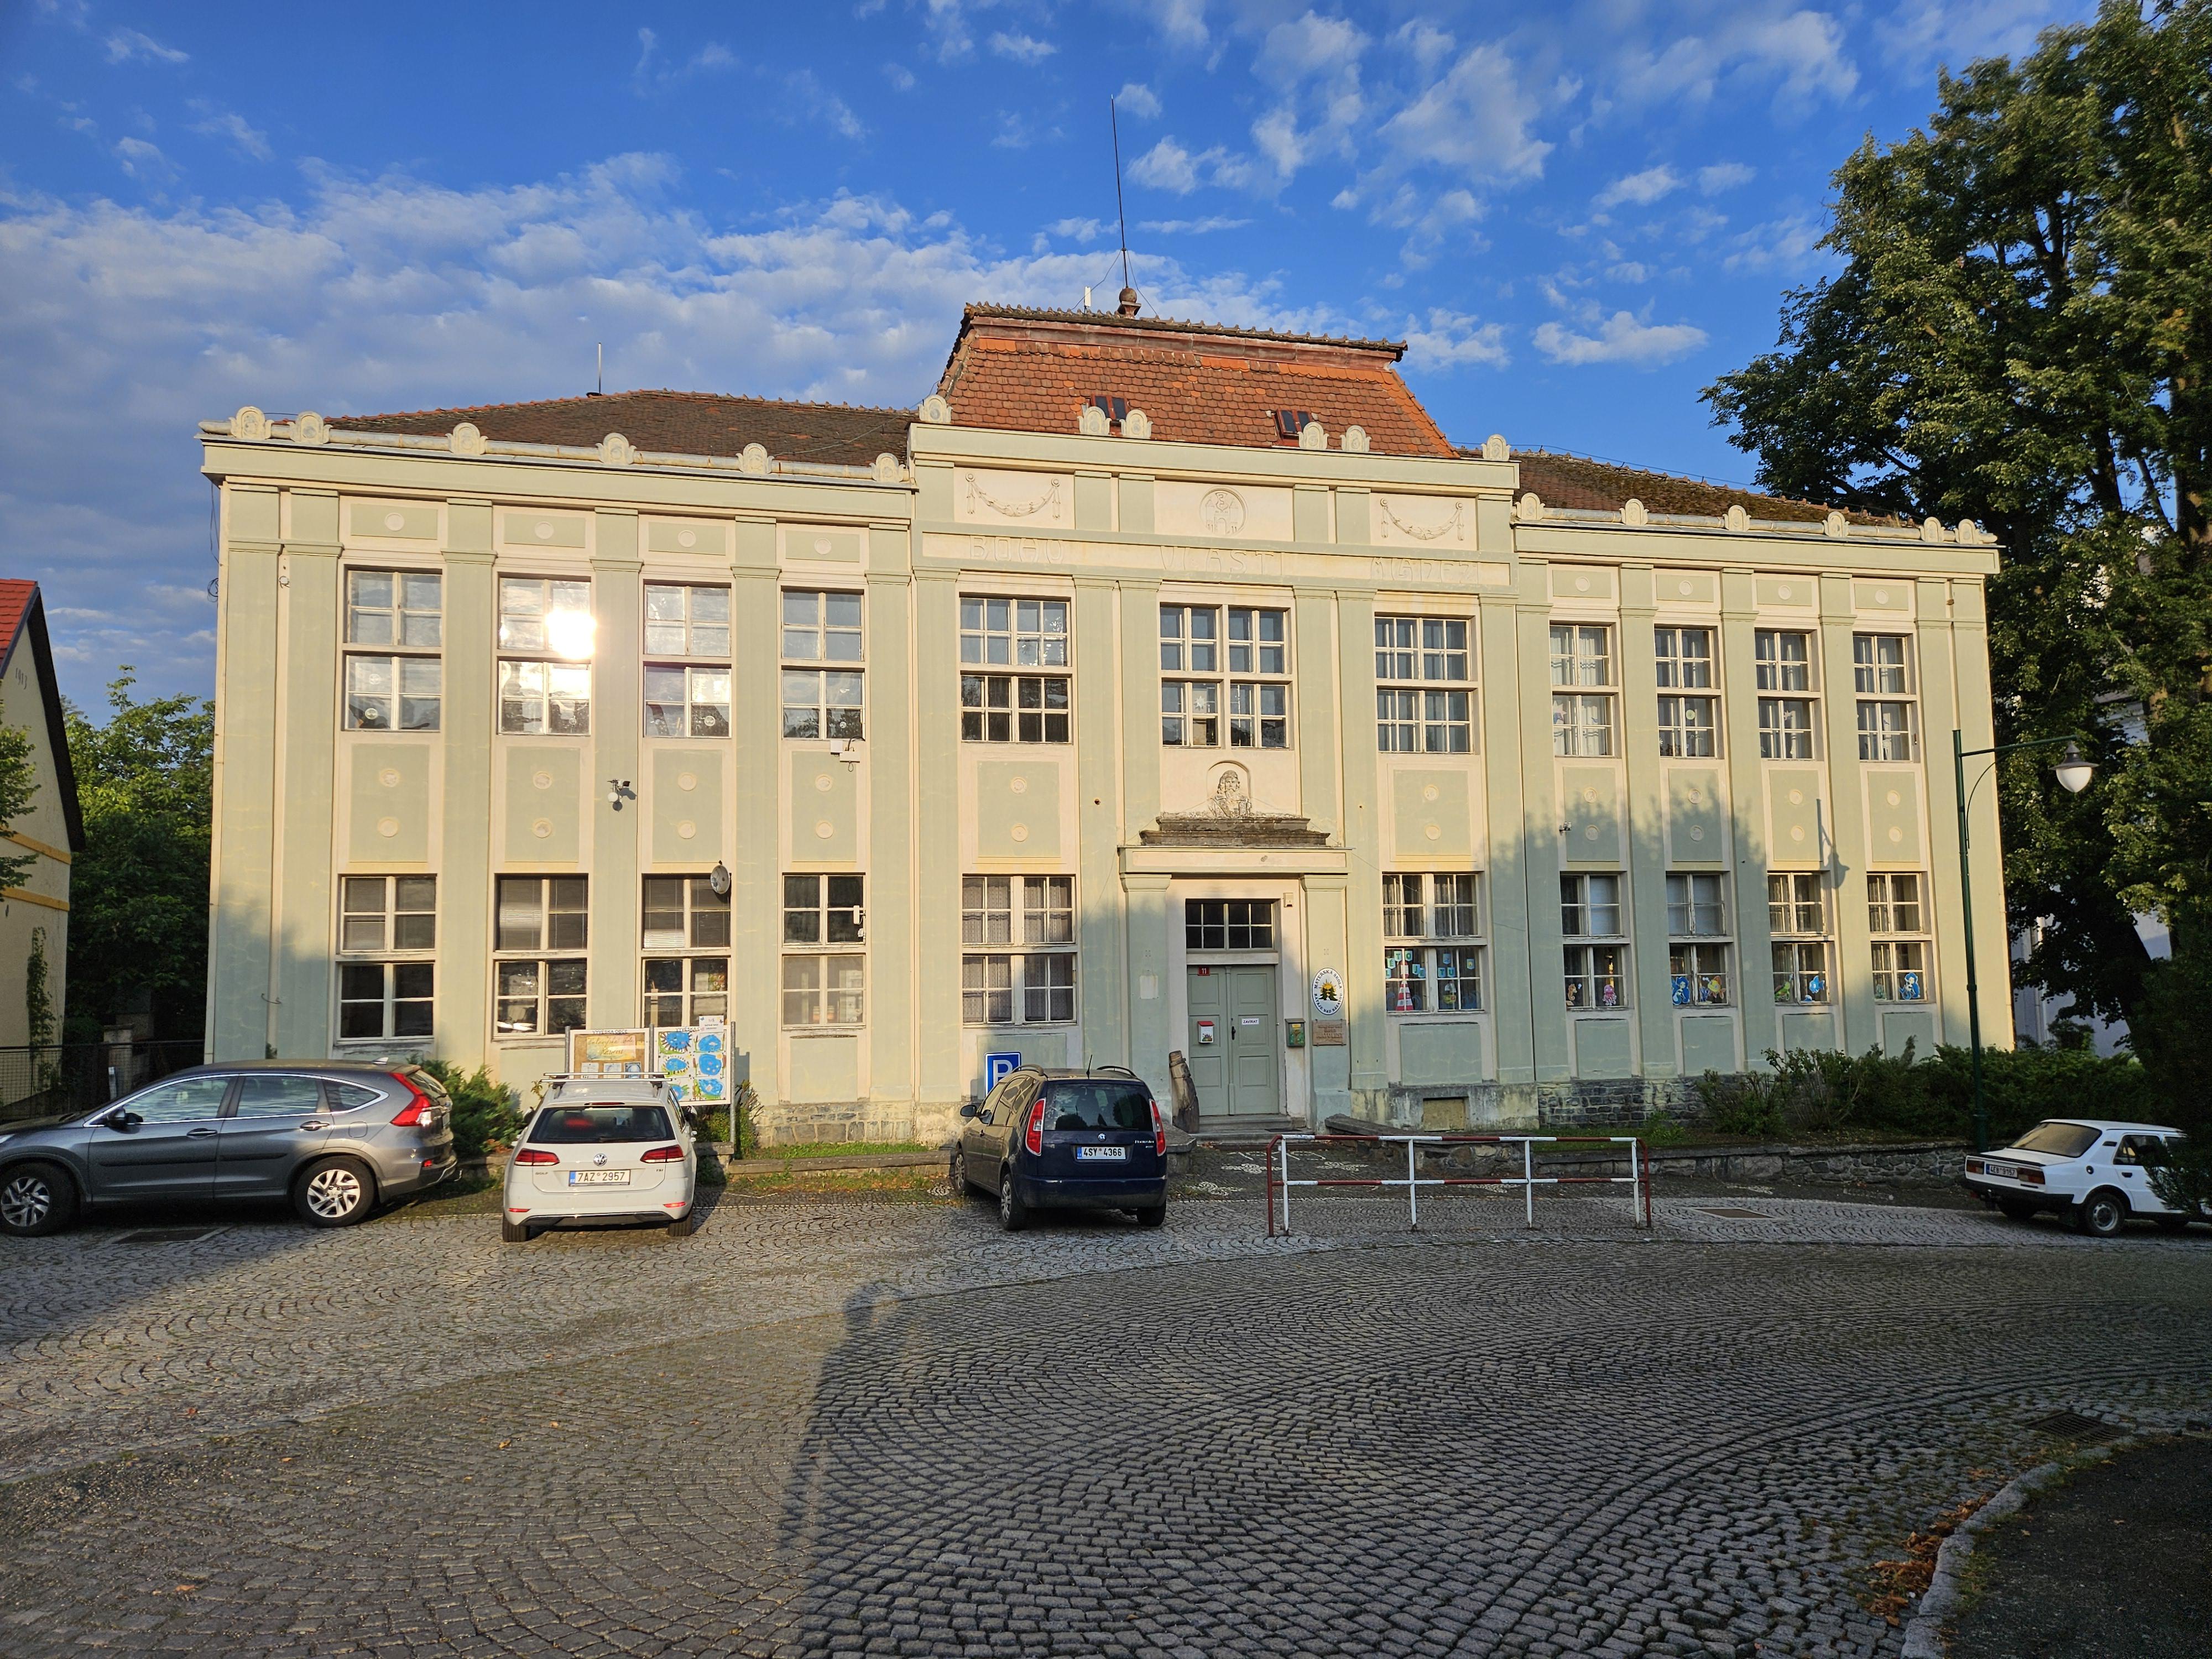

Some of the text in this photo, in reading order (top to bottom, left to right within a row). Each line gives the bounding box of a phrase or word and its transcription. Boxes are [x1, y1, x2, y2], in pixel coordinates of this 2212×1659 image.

[993, 1060, 1013, 1087] P
[1083, 1148, 1122, 1156] 4SY 4366
[578, 1172, 595, 1182] 7AZ
[602, 1172, 625, 1181] 2957
